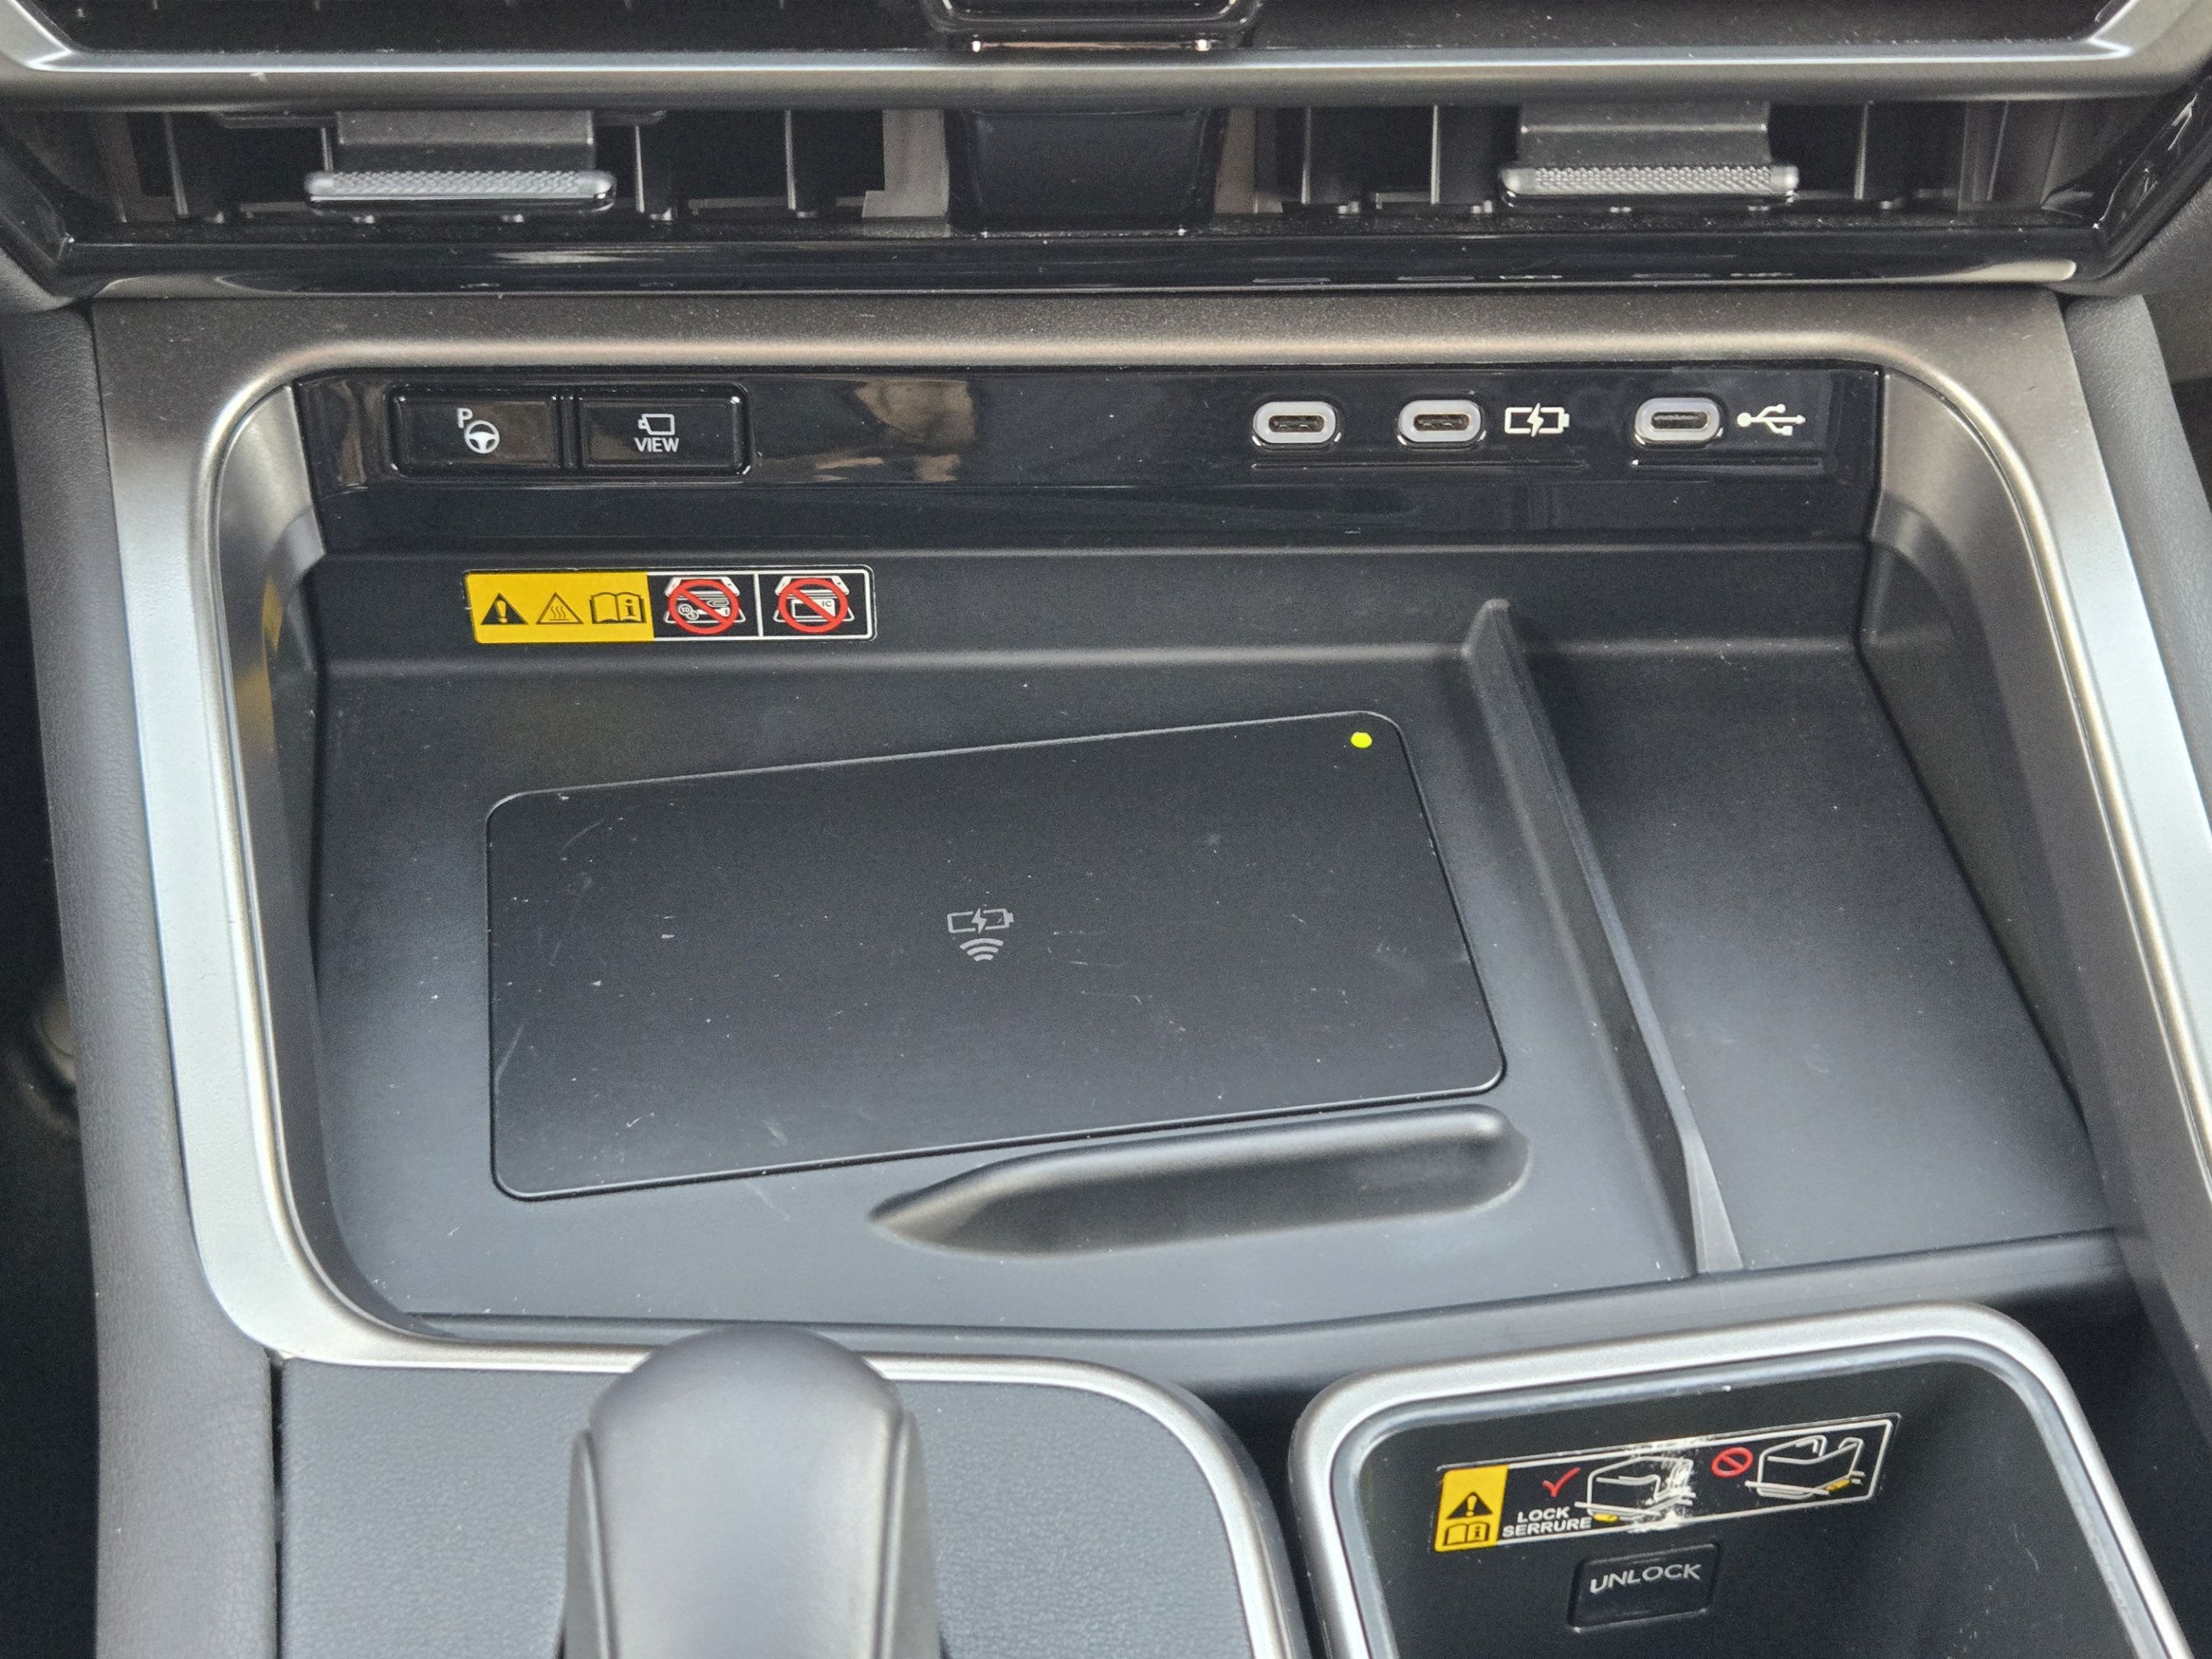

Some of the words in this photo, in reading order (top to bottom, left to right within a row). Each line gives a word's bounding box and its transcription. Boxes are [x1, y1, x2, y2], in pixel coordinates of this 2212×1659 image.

[634, 436, 680, 452] VIEW
[1517, 1506, 1571, 1523] LOCK
[1502, 1517, 1592, 1538] SERRURE
[1589, 1564, 1702, 1594] UNLOCK
